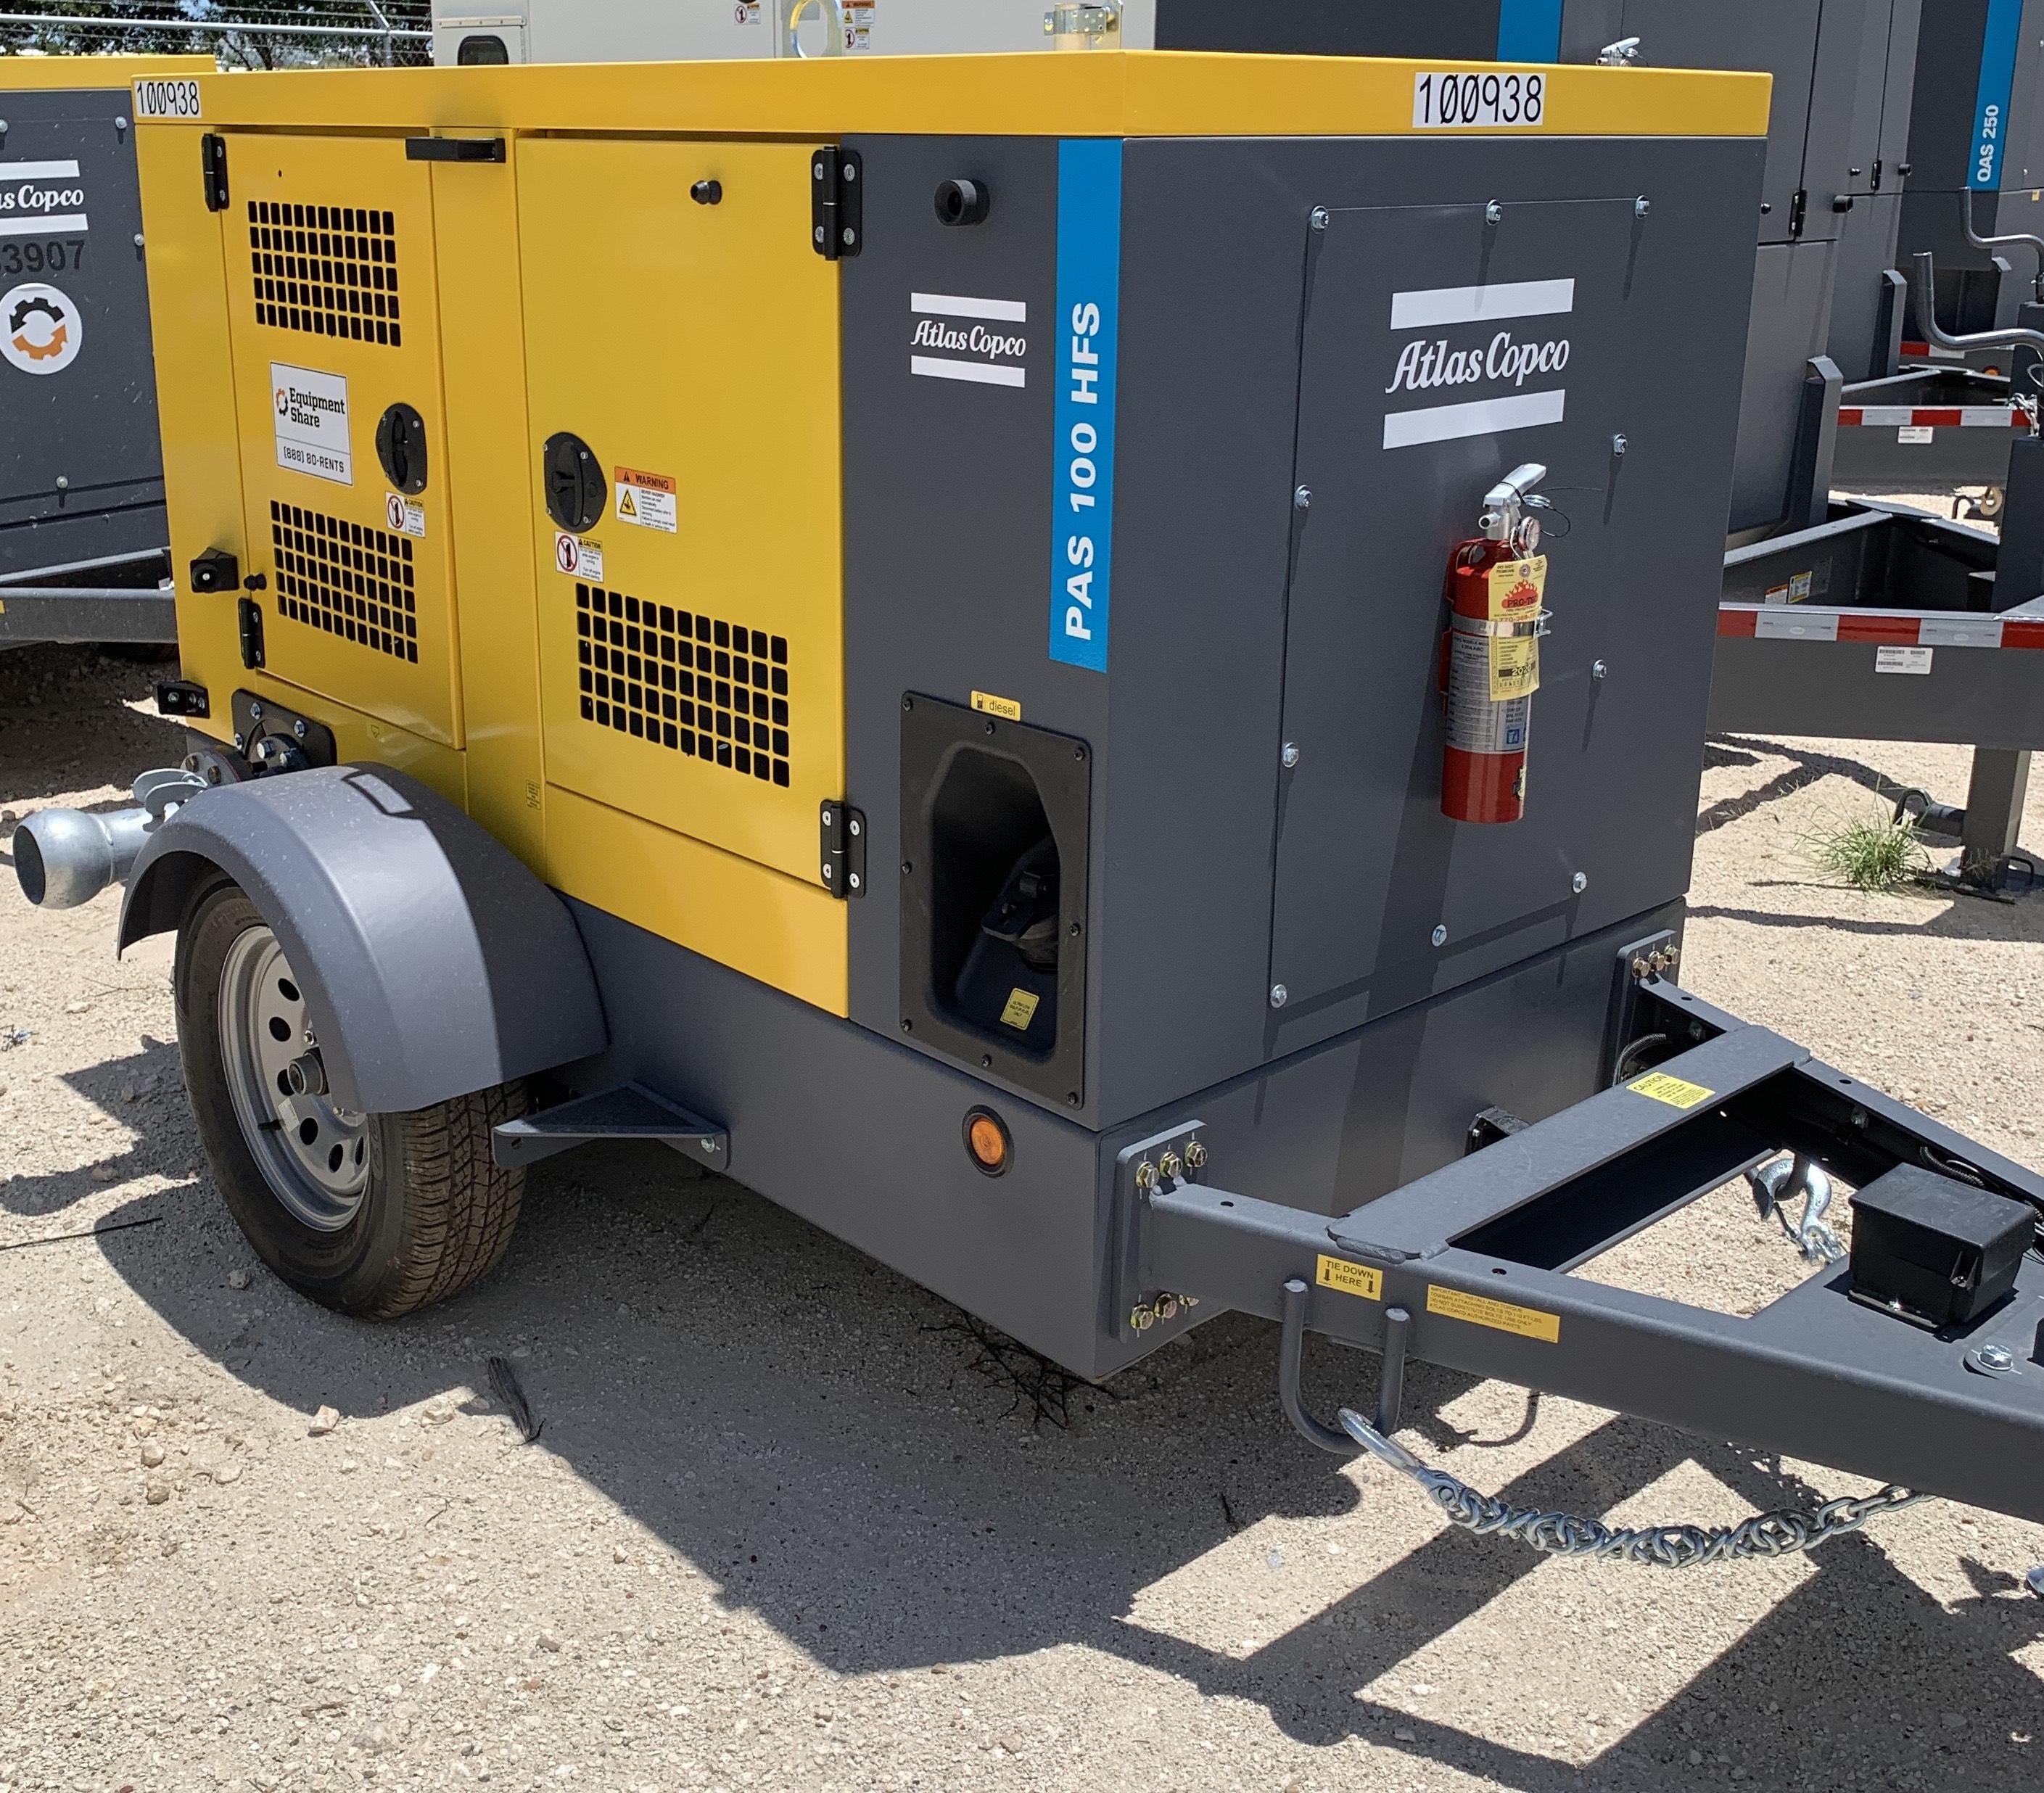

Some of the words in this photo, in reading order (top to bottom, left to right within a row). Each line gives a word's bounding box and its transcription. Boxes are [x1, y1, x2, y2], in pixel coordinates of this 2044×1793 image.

[137, 81, 199, 115] 100938
[1419, 74, 1541, 123] 100938
[1982, 104, 1999, 139] 250
[17, 184, 84, 213] Copco
[910, 320, 968, 350] Atlas
[970, 325, 1026, 359] Copco
[1071, 302, 1100, 404] HFS
[1385, 340, 1483, 393] Atlas
[1485, 331, 1569, 387] Copco
[289, 387, 345, 414] Equipment
[291, 407, 320, 427] Share
[284, 446, 304, 463] (888)
[307, 453, 344, 473] 80-RENTS
[1070, 423, 1097, 512] 100
[635, 474, 669, 490] WARNING
[583, 539, 601, 550] CAUTION
[1066, 535, 1094, 640] PAS
[1512, 664, 1532, 676] 2020
[989, 700, 1015, 717] diesel
[1633, 1075, 1667, 1092] CAUTION
[1326, 1260, 1341, 1271] TIE
[1343, 1265, 1374, 1279] DOWN
[1335, 1274, 1363, 1287] HERE
